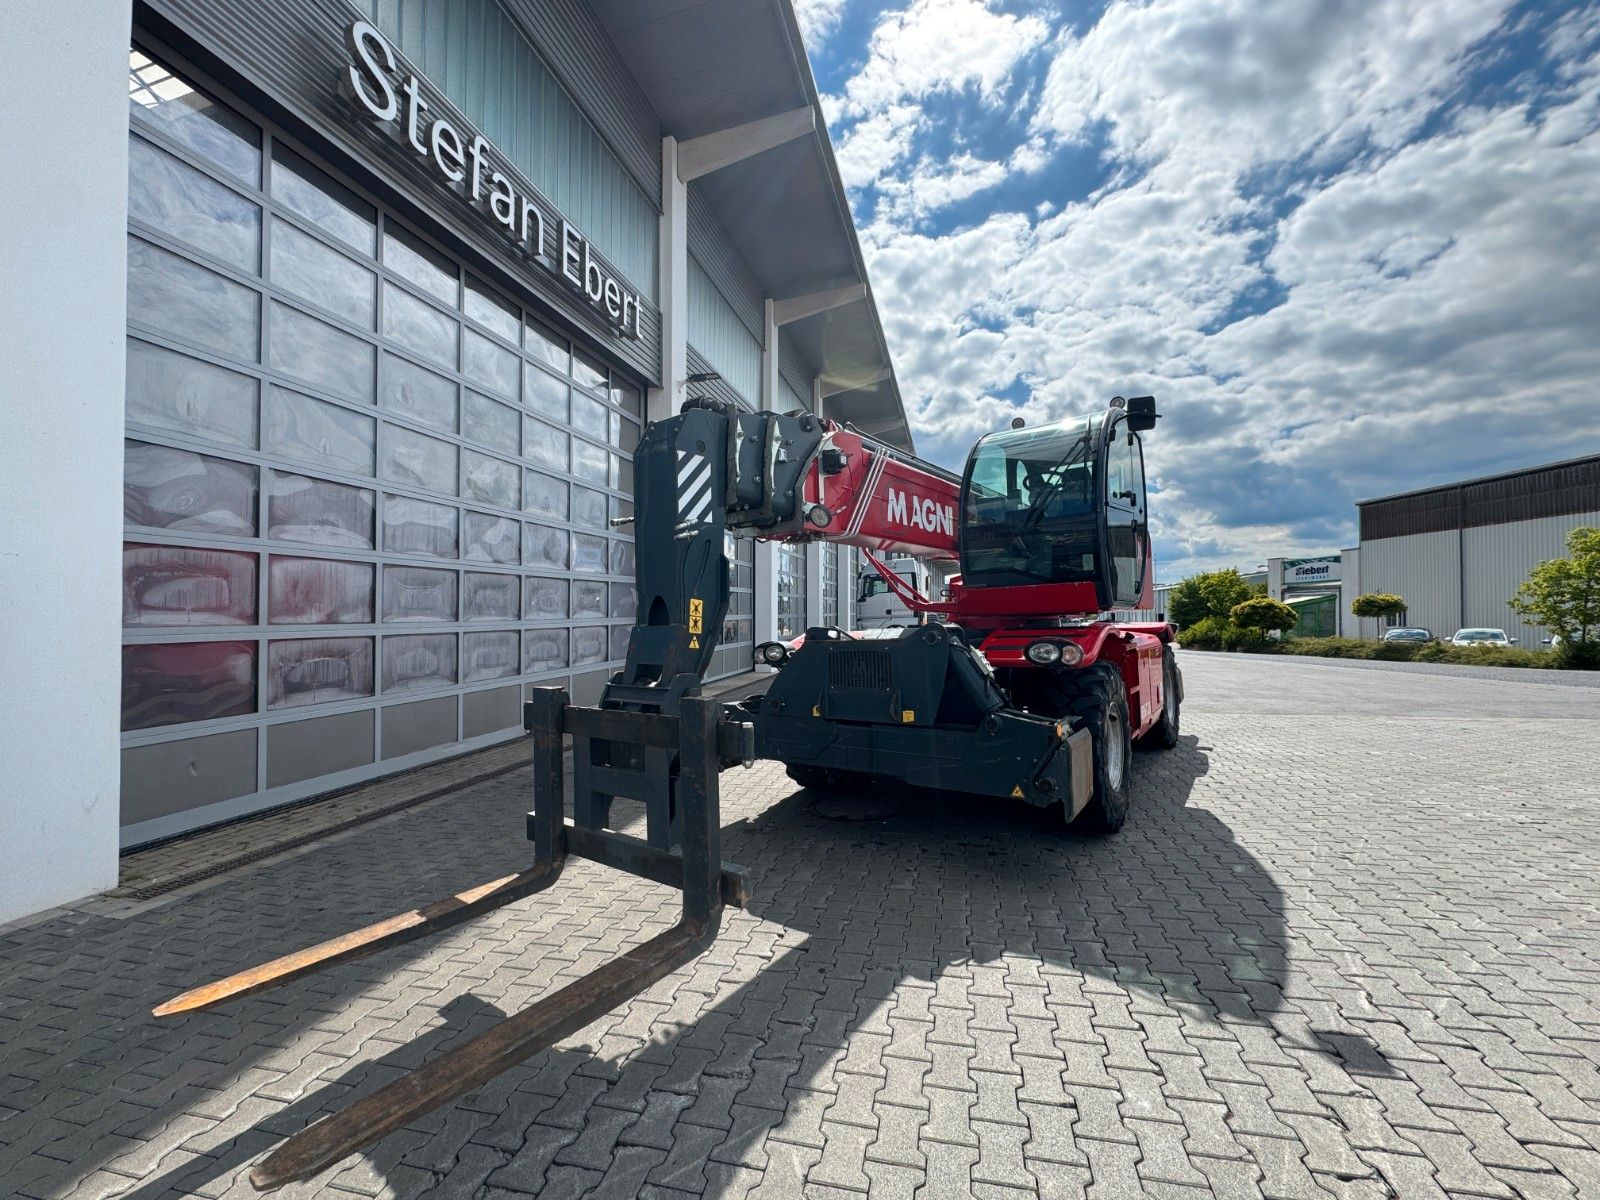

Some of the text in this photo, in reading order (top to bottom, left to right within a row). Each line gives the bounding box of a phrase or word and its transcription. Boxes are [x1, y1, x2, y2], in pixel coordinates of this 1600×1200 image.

[349, 21, 644, 340] Stefan Ebert
[886, 487, 954, 537] MAGNI
